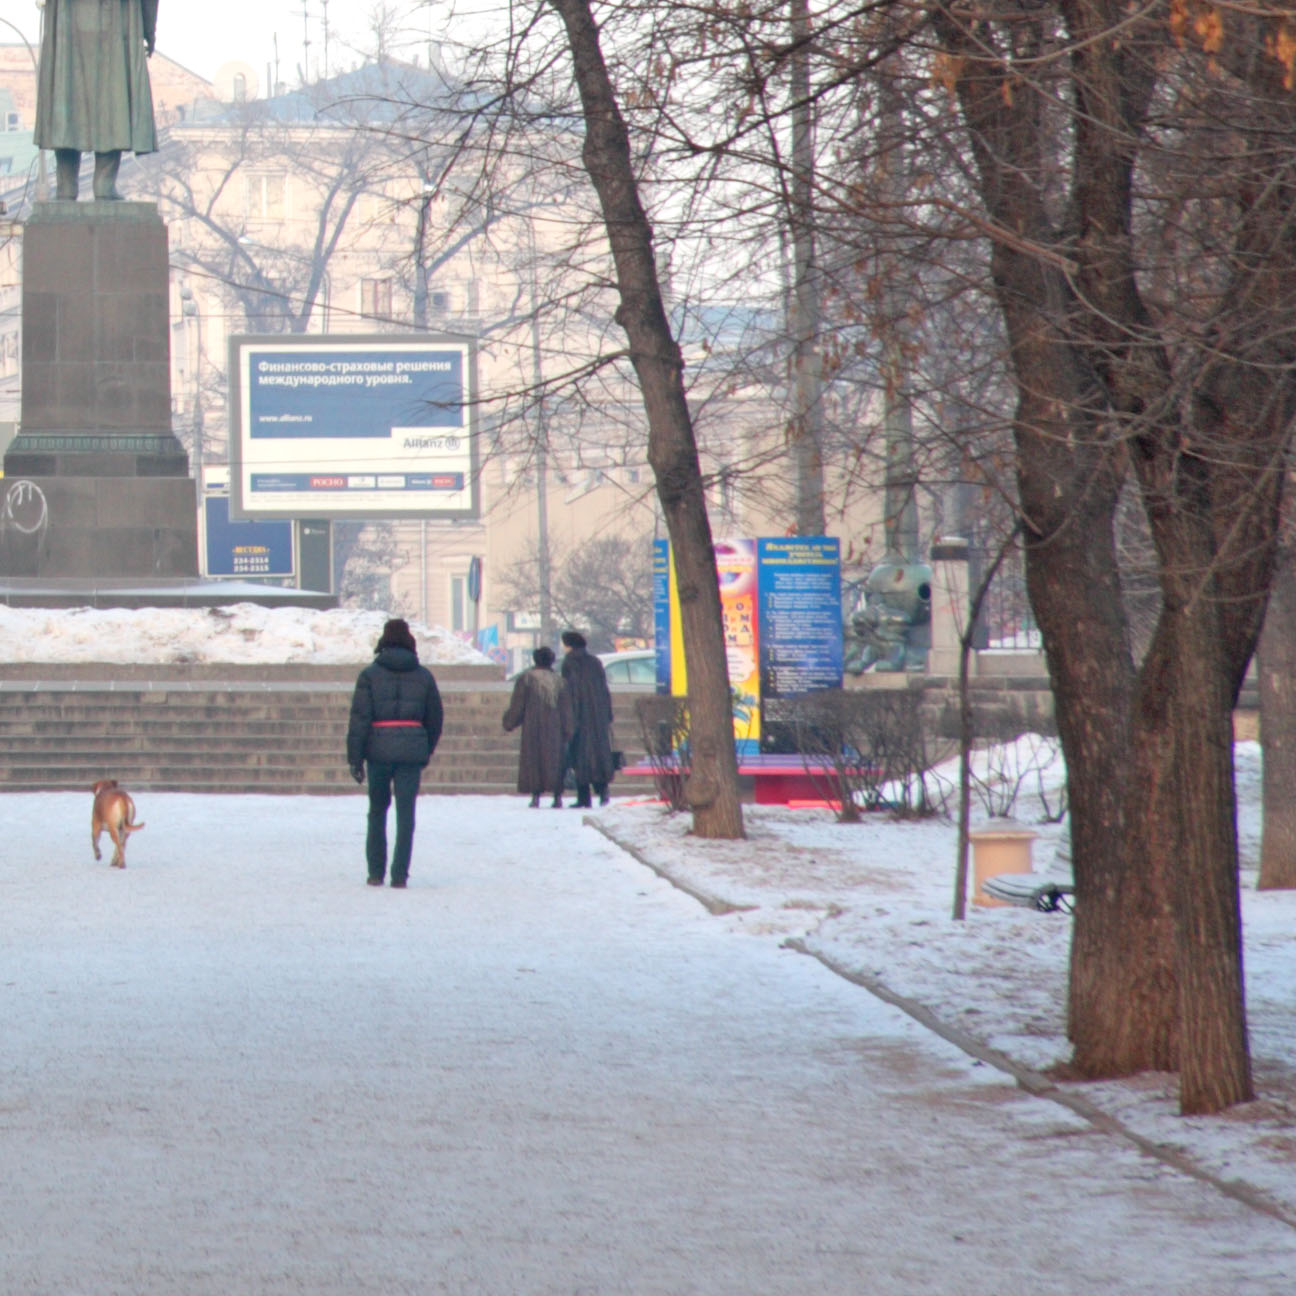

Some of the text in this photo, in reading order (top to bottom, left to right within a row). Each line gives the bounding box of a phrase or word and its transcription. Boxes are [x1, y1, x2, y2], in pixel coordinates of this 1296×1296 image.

[258, 361, 451, 374] Финансово-страховые решения
[258, 374, 412, 387] международного уровня.
[403, 438, 442, 449] Allianz
[313, 478, 344, 487] РОСНО
